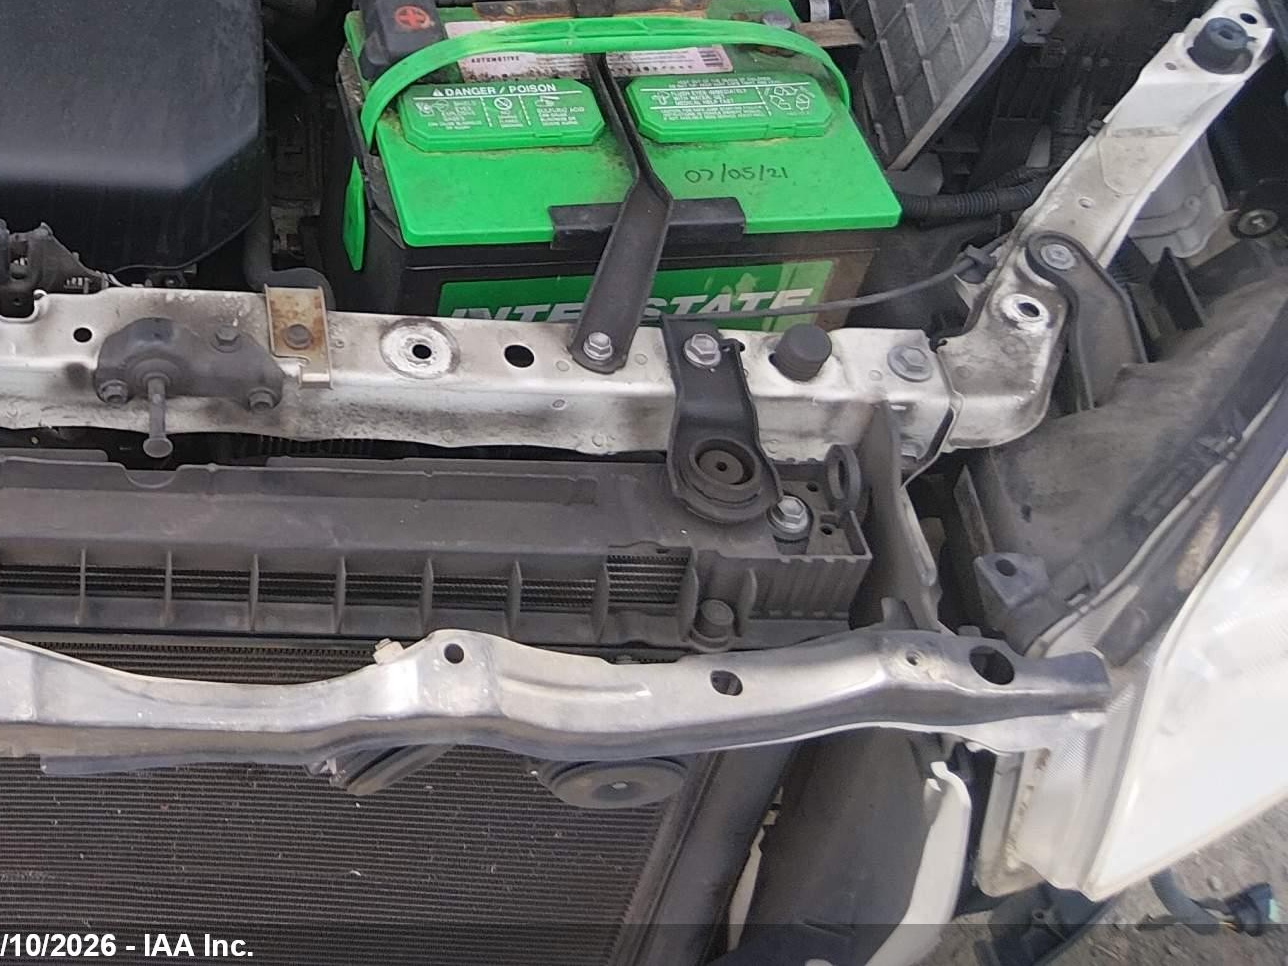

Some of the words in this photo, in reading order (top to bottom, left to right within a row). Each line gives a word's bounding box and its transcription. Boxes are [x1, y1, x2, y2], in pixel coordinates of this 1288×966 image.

[471, 55, 520, 64] AUTOMOTIVE
[444, 86, 496, 97] DANGER
[509, 84, 557, 93] POISON
[684, 163, 788, 184] 07/05/21
